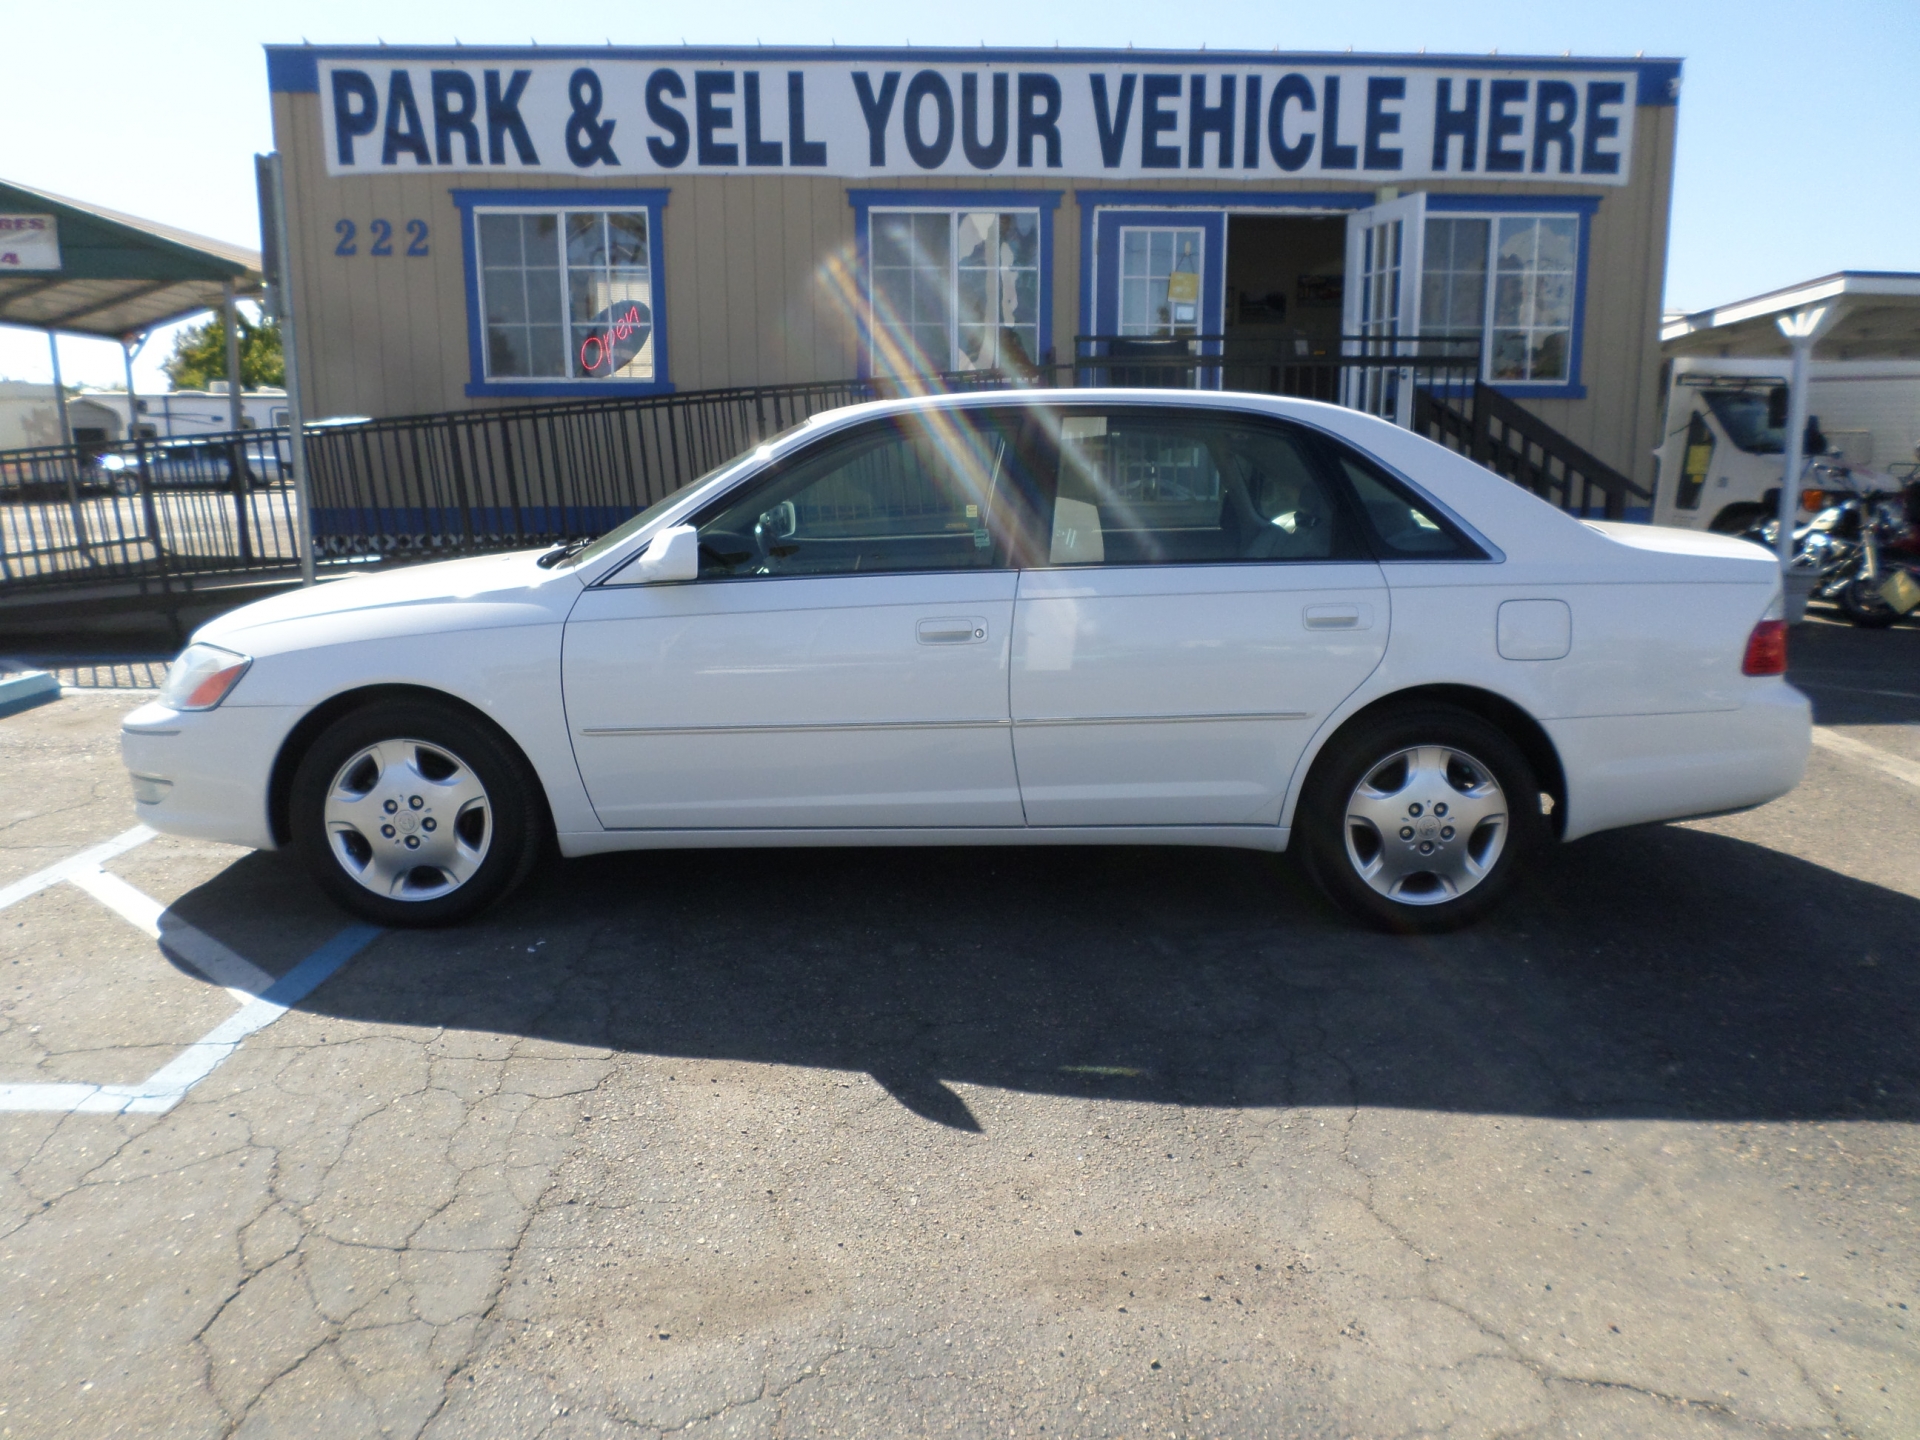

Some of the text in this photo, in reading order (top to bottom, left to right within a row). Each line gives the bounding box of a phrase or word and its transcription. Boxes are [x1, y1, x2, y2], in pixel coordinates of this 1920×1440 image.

[331, 67, 1626, 175] PARK & SELL YOUR VEHICLE HERE
[581, 305, 641, 370] Open
